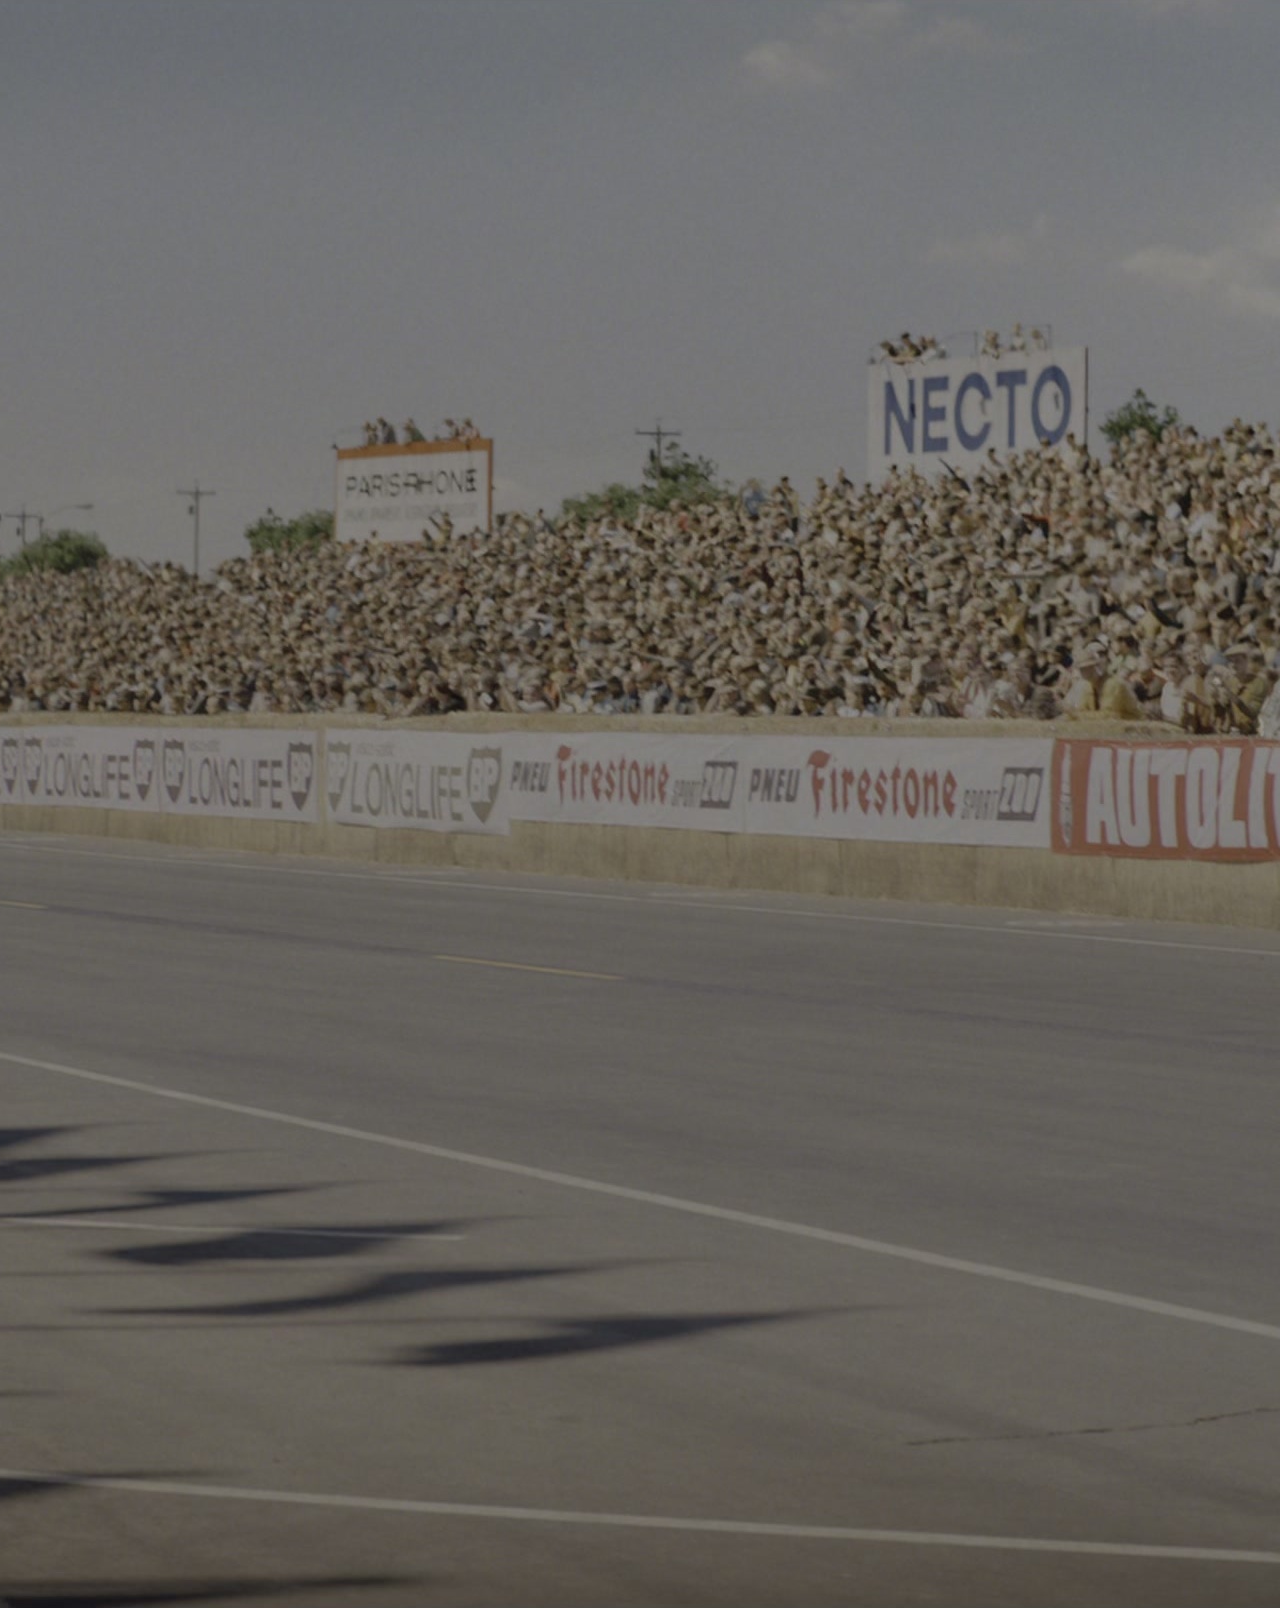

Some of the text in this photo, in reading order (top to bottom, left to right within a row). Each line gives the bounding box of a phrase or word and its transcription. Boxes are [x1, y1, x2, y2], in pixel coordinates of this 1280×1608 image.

[884, 364, 1072, 455] NECTO
[43, 752, 130, 800] LONGLIFE
[187, 756, 283, 810] LONGLIFE
[351, 762, 465, 822] LONGLIFE
[468, 757, 501, 803] BP
[509, 760, 552, 793] PNEU
[556, 744, 670, 807] Firestone
[749, 767, 801, 803] PNEU
[807, 749, 958, 819] Firestone
